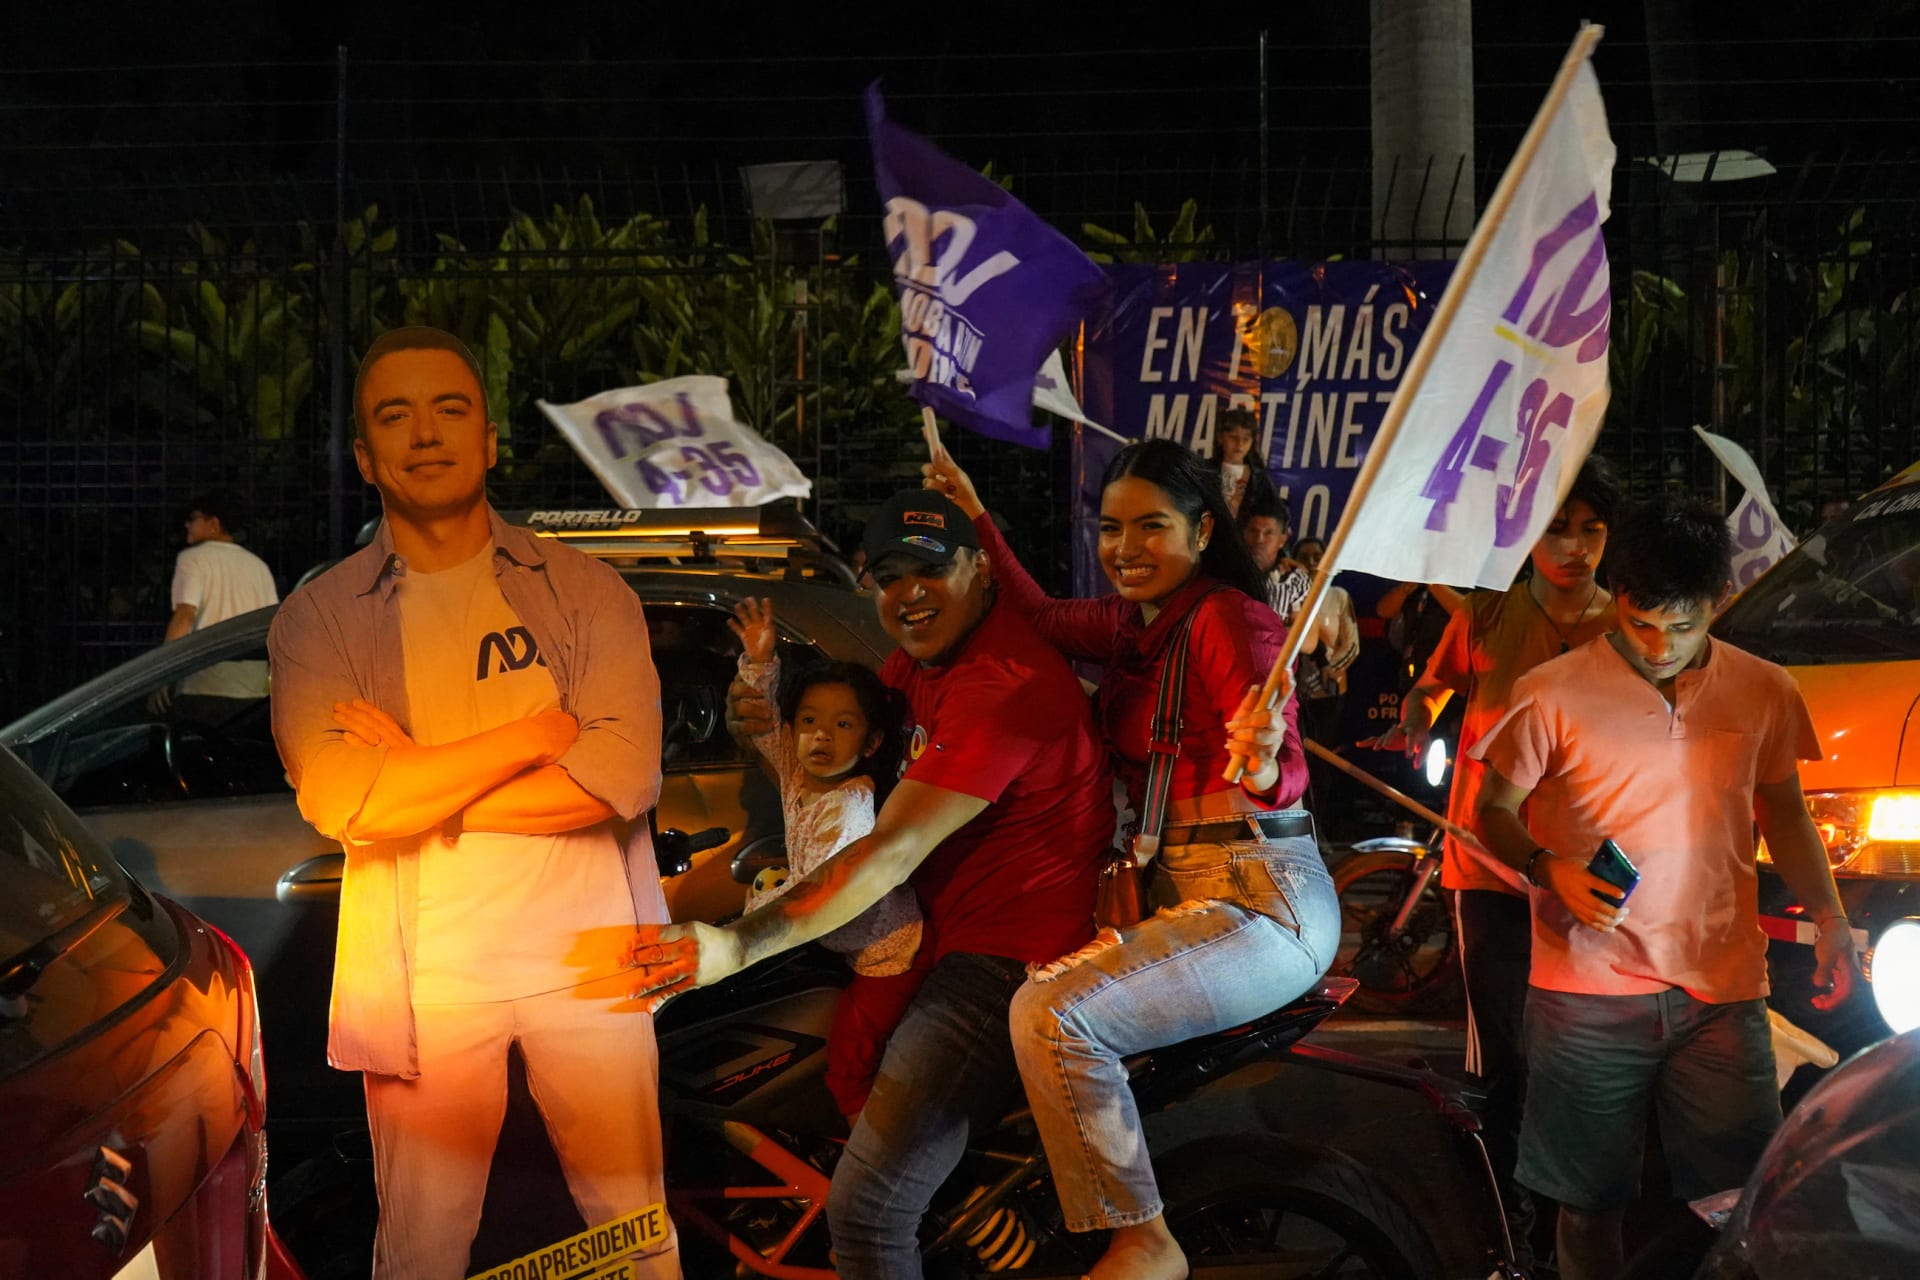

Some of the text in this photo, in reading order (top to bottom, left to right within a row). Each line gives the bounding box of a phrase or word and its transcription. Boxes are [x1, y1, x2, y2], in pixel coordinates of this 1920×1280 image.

[1140, 284, 1408, 382] EN TMÁS
[1144, 371, 1398, 469] MATÍNE
[528, 509, 642, 524] PORTELLO
[714, 1052, 792, 1092] DUKE
[482, 1208, 662, 1280] OAPRESIDENTE
